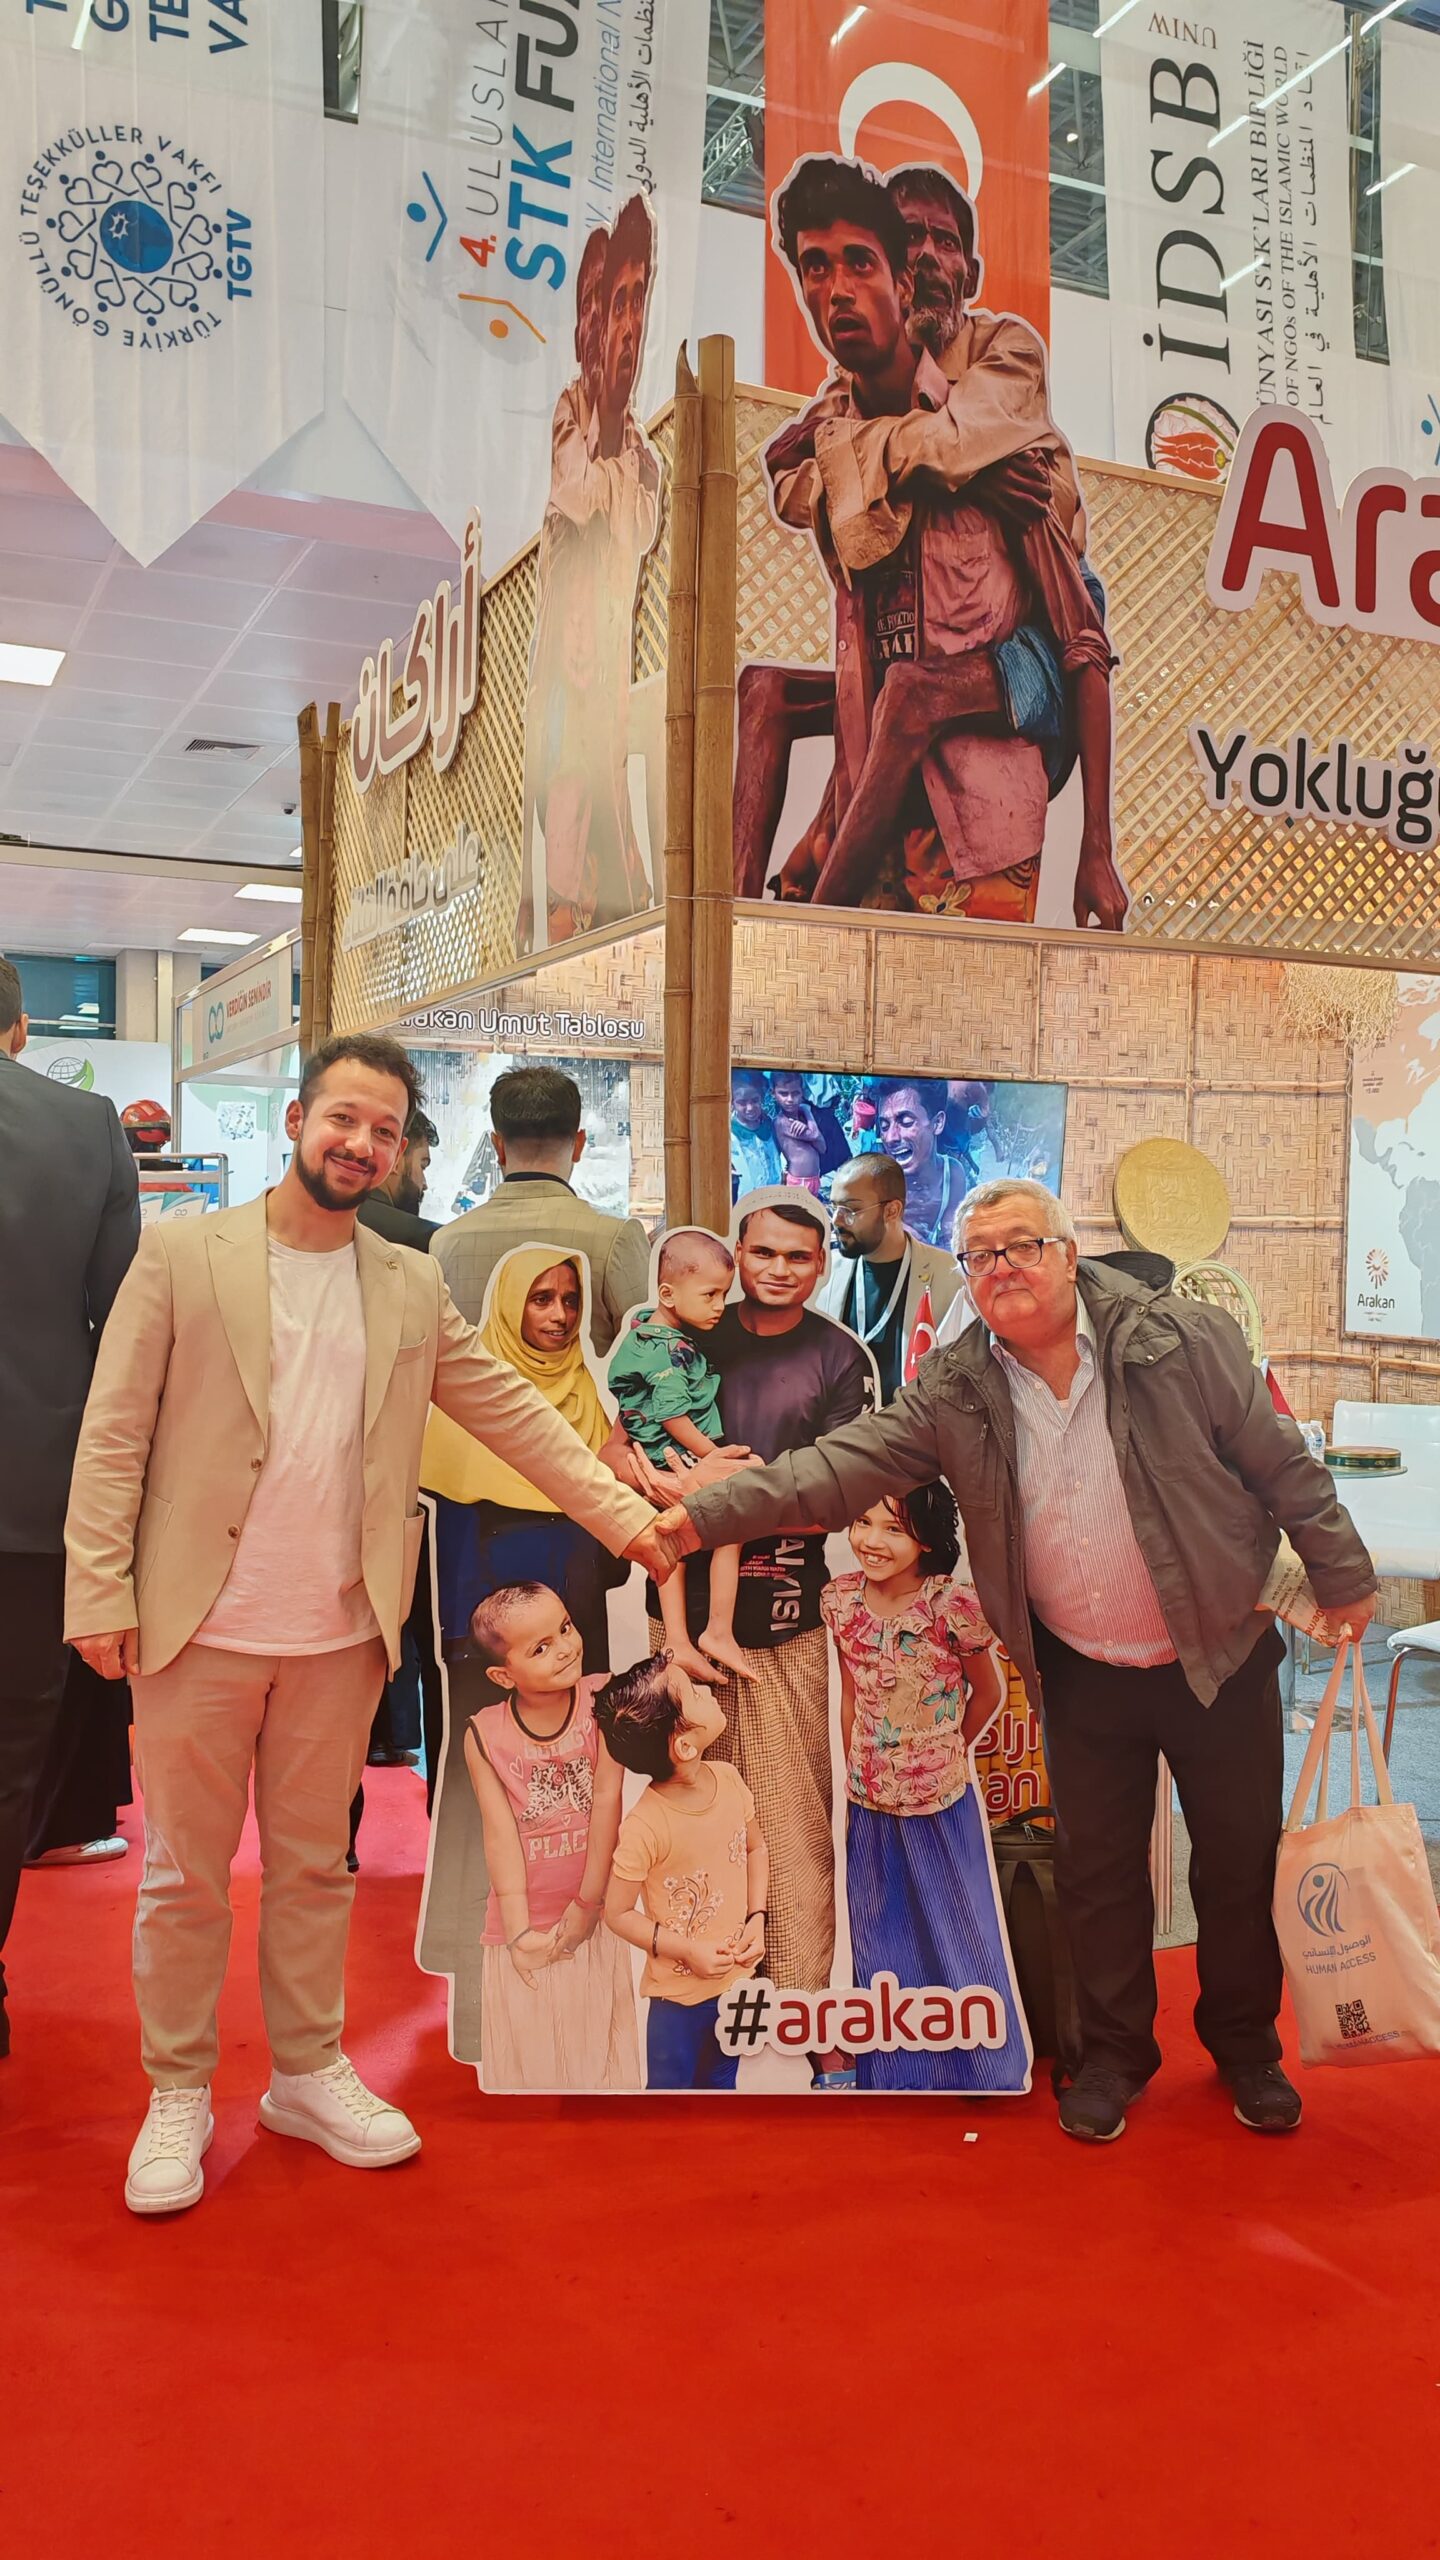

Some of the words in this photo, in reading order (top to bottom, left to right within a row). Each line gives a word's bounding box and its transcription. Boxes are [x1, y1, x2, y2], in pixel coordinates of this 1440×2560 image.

[515, 0, 580, 112] FU
[1148, 12, 1218, 50] UNIW
[465, 0, 509, 216] ULUSLA
[588, 19, 621, 193] International
[1274, 46, 1289, 126] WORLD
[20, 125, 143, 216] TEŞEKKÜLLER
[158, 135, 222, 194] VAKFI
[1276, 133, 1292, 225] ISLAMIC
[505, 123, 572, 290] STK
[1142, 58, 1231, 375] İDSB
[19, 231, 110, 337] GÖNÜLLÜ
[226, 208, 252, 301] TGTV
[459, 235, 496, 267] 4.
[1280, 231, 1294, 274] THE
[1282, 280, 1296, 309] OF
[123, 311, 222, 352] TÜRKİYE
[1283, 316, 1298, 372] NGOs
[1286, 377, 1299, 406] OF
[352, 519, 475, 783] أراكان
[1198, 730, 1440, 845] Yokluğ
[400, 1009, 473, 1029] rakan
[479, 1008, 551, 1036] Umut
[555, 1011, 645, 1039] Tablosu
[1357, 1293, 1395, 1309] Arakan
[1306, 1962, 1338, 1975] HUMAN
[1340, 1952, 1376, 1972] ACCESS
[724, 1982, 998, 2047] #arakan
